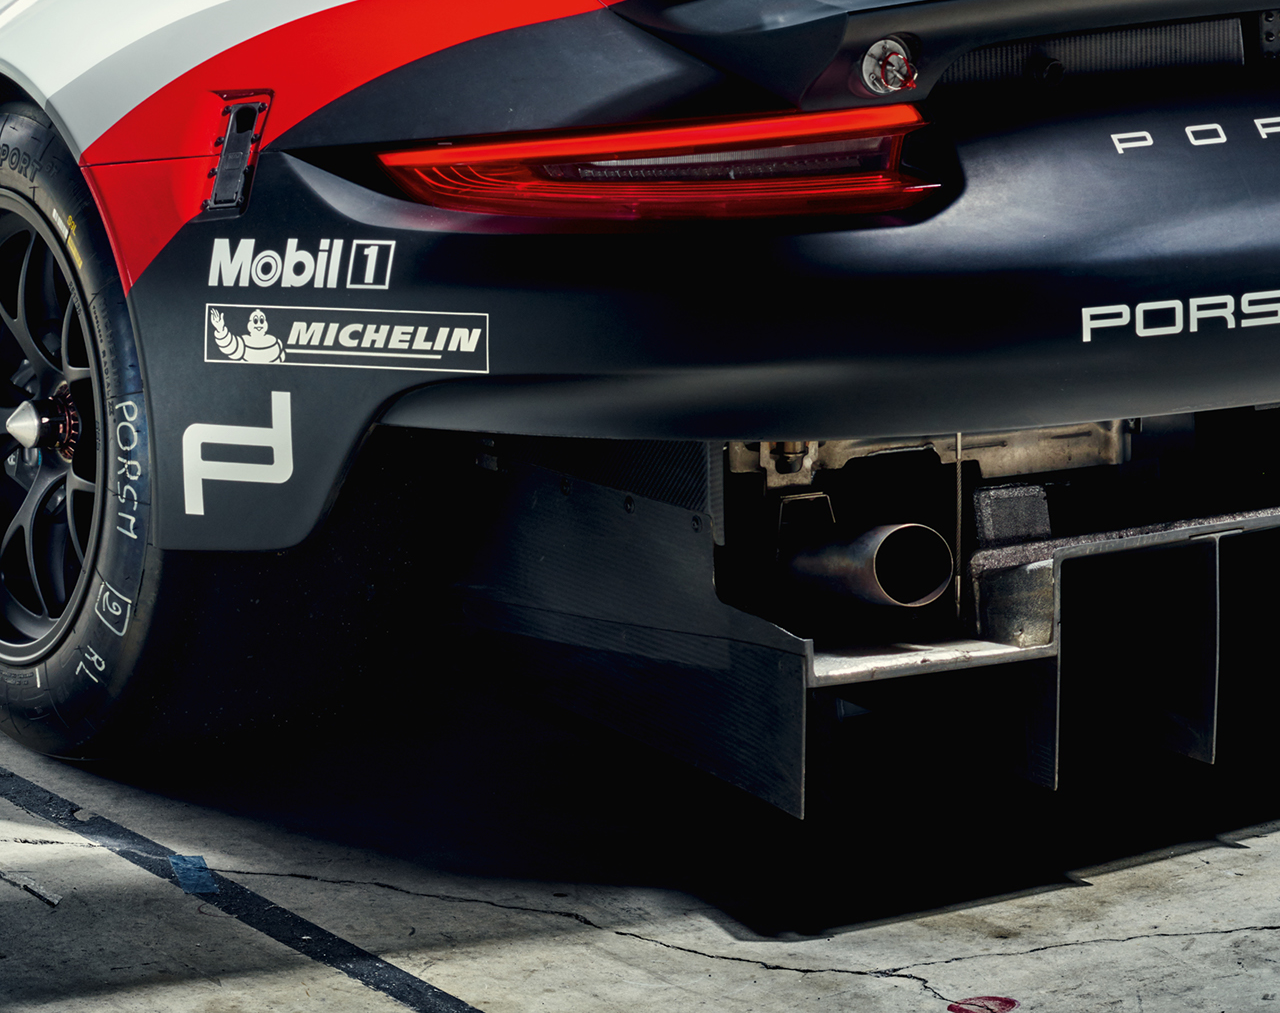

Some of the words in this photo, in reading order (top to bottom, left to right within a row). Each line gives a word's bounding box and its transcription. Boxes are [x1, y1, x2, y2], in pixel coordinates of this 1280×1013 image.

[208, 238, 344, 289] Mobil
[287, 321, 482, 352] MICHELIN
[75, 644, 106, 683] RL
